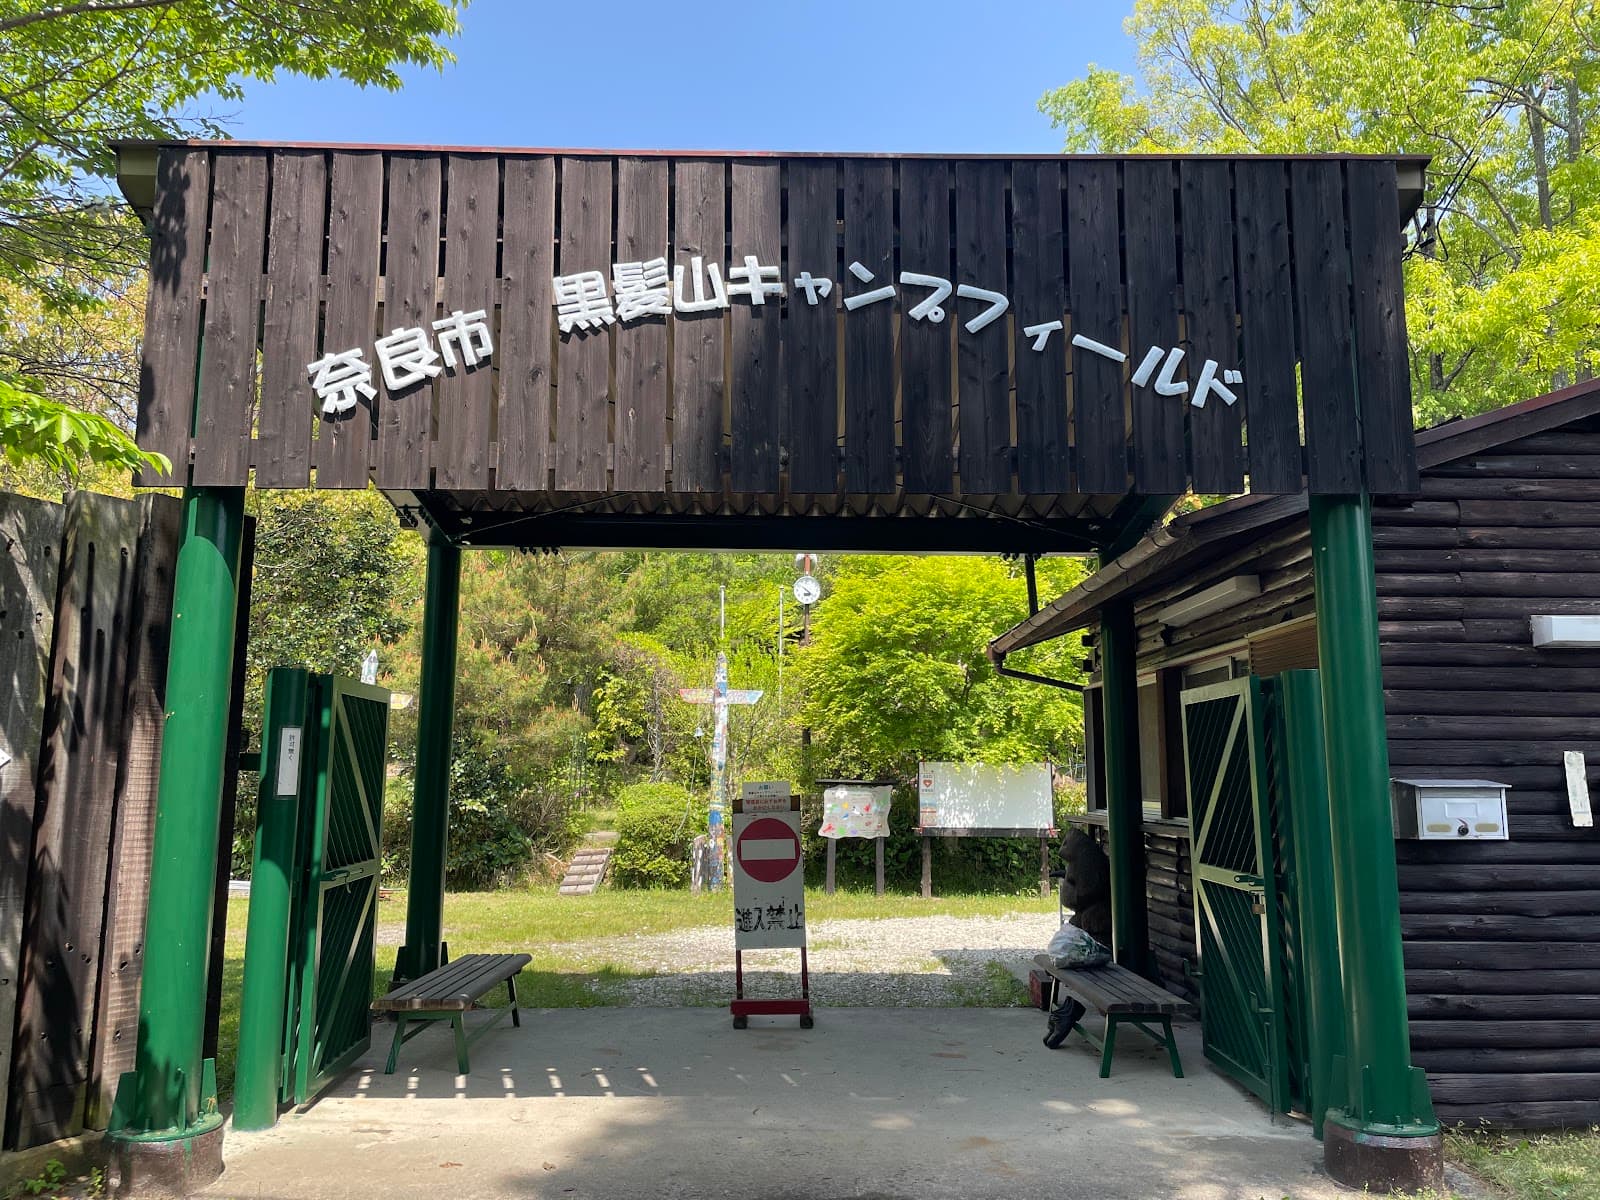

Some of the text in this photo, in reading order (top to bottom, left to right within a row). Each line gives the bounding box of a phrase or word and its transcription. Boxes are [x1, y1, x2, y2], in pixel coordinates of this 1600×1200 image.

[306, 255, 1243, 414] 奈良市 黒髪山キャンプフィールド
[735, 903, 803, 932] 進入禁止
